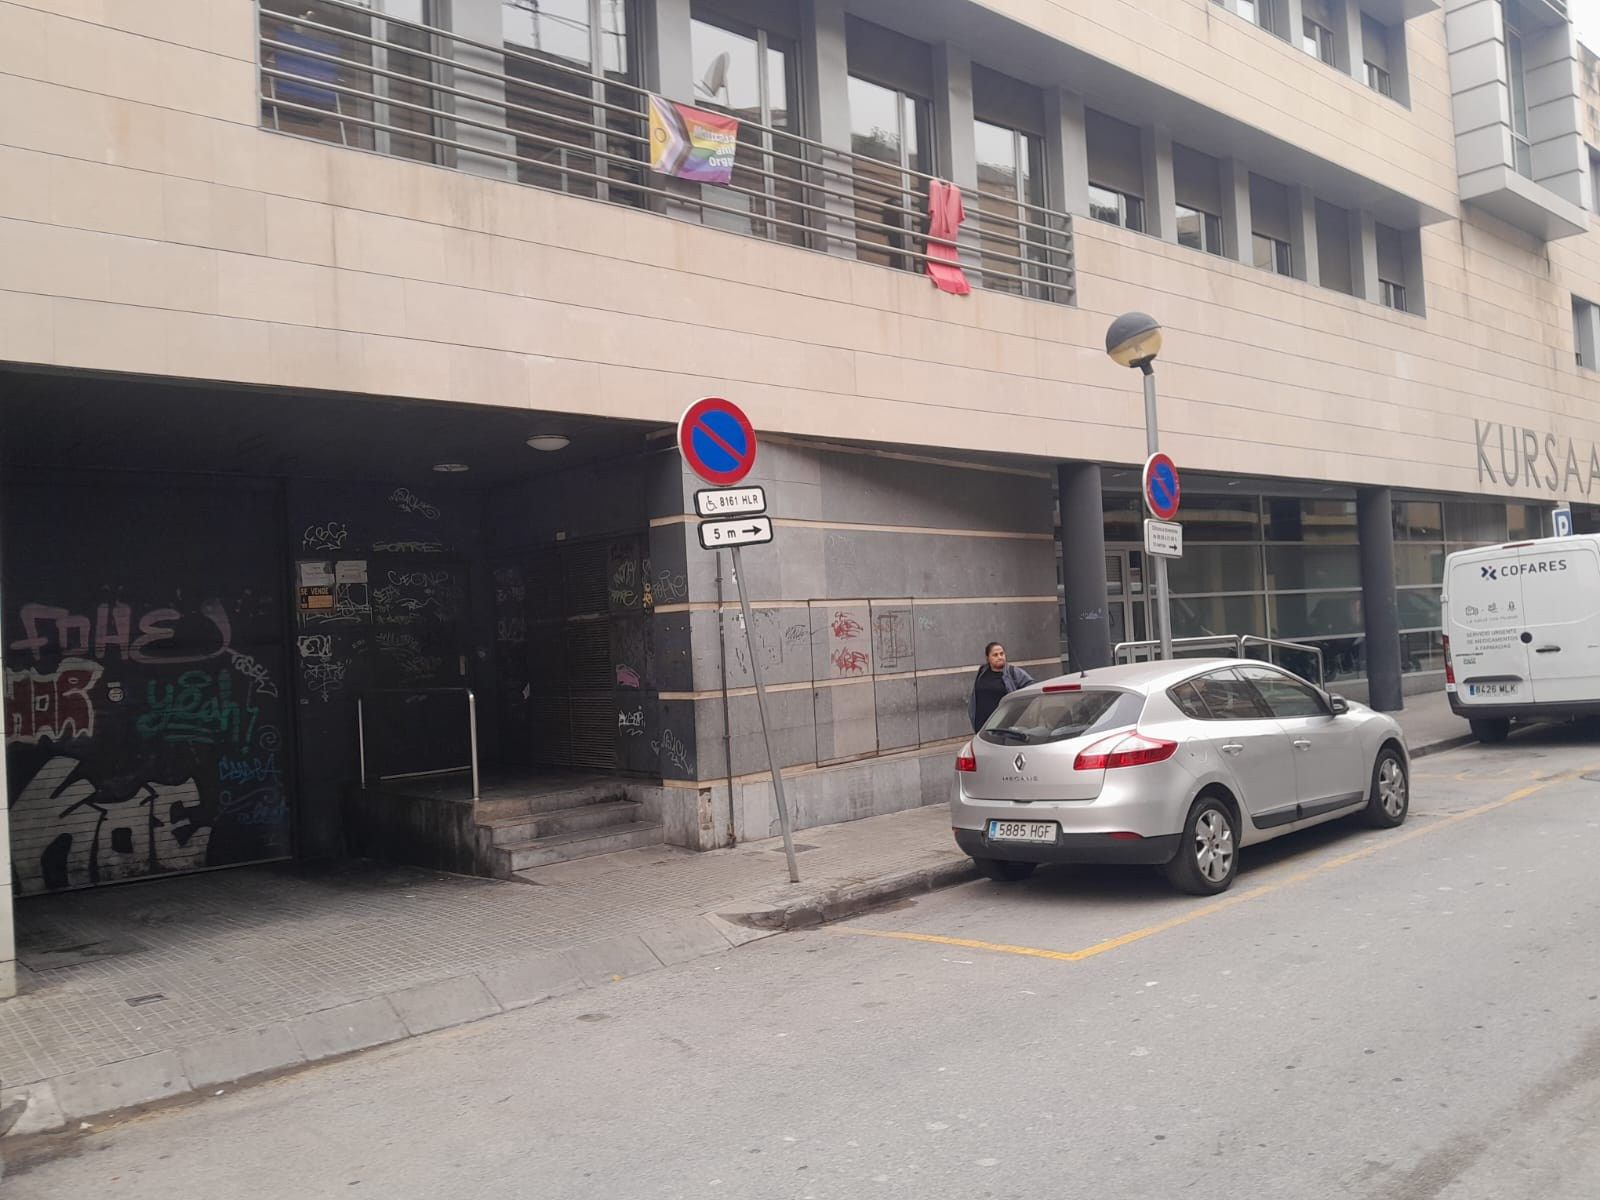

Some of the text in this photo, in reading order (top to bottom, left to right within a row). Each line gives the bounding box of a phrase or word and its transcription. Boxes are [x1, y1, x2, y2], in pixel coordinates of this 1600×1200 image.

[719, 494, 758, 507] 8161 HLR
[714, 528, 736, 540] 5 m
[1501, 559, 1567, 577] COFARES
[300, 587, 329, 596] SE VENDE
[999, 823, 1052, 839] 5885 HGF
